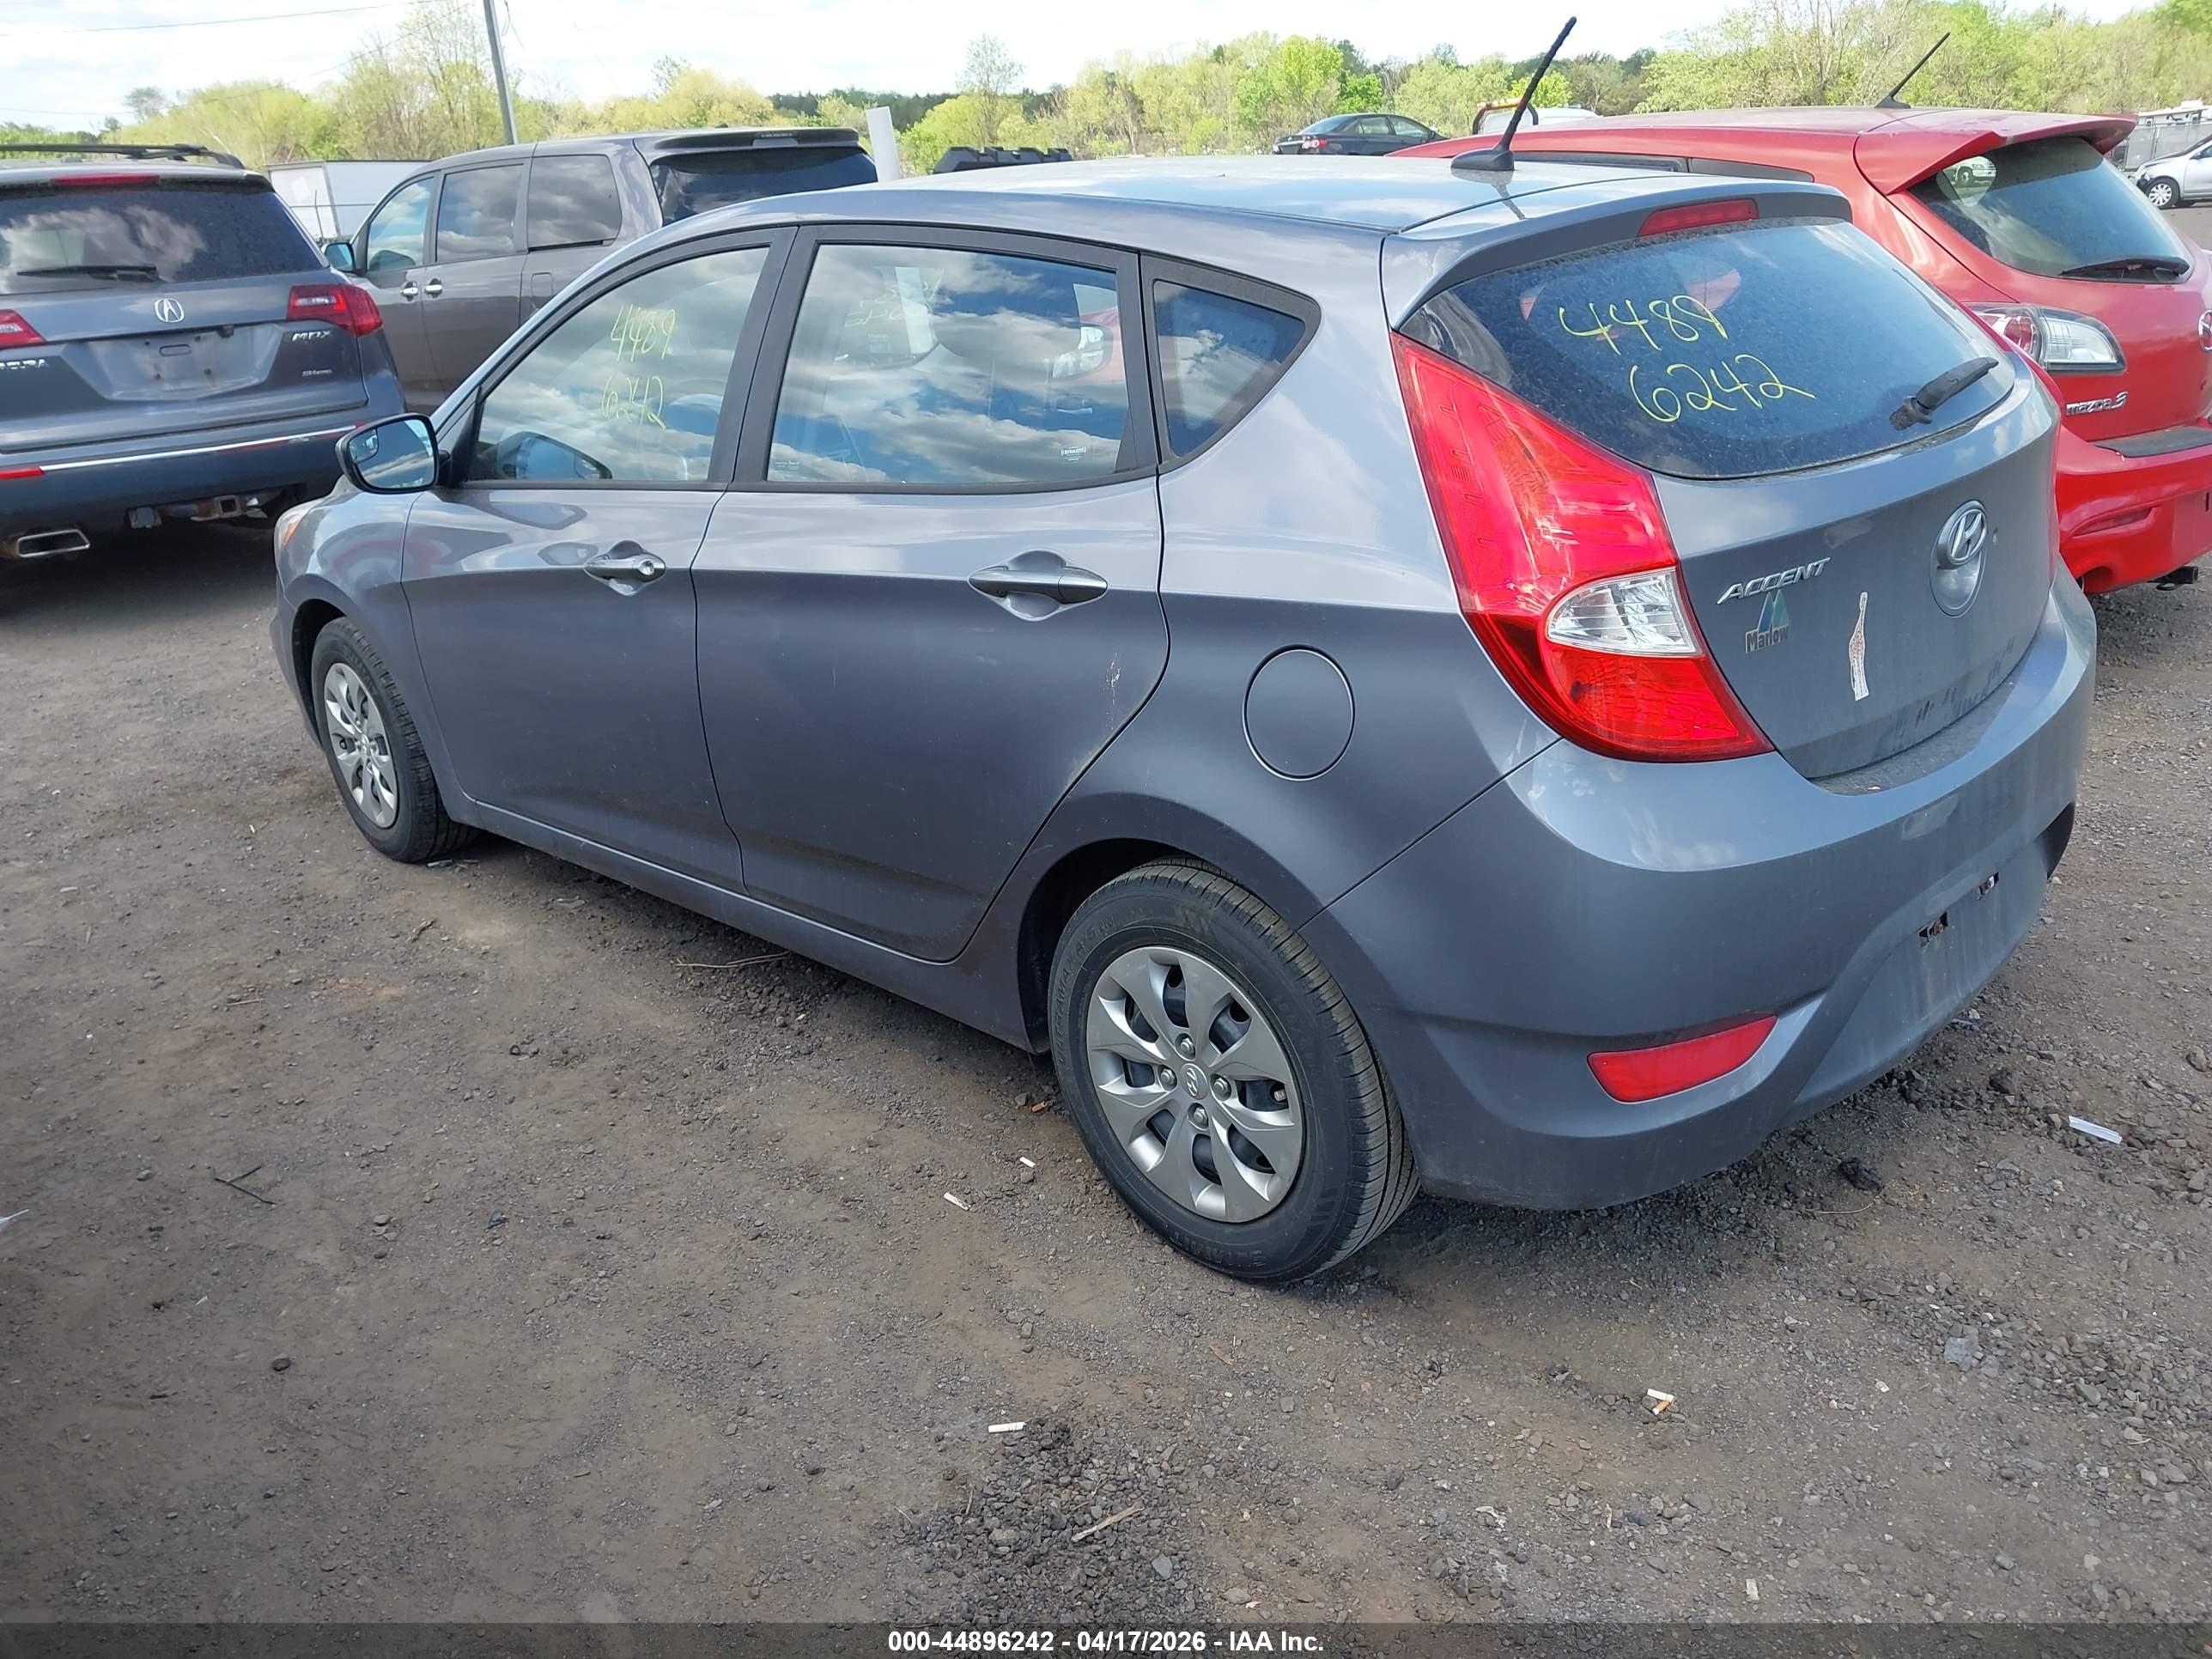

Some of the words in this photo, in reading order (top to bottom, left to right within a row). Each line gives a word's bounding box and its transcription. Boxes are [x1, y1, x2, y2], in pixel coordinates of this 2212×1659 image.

[1559, 295, 1729, 356] 4489
[602, 375, 667, 429] 6242
[1630, 354, 1817, 422] 6242
[1717, 556, 1832, 605] ACCENT
[1747, 625, 1790, 653] Marlow
